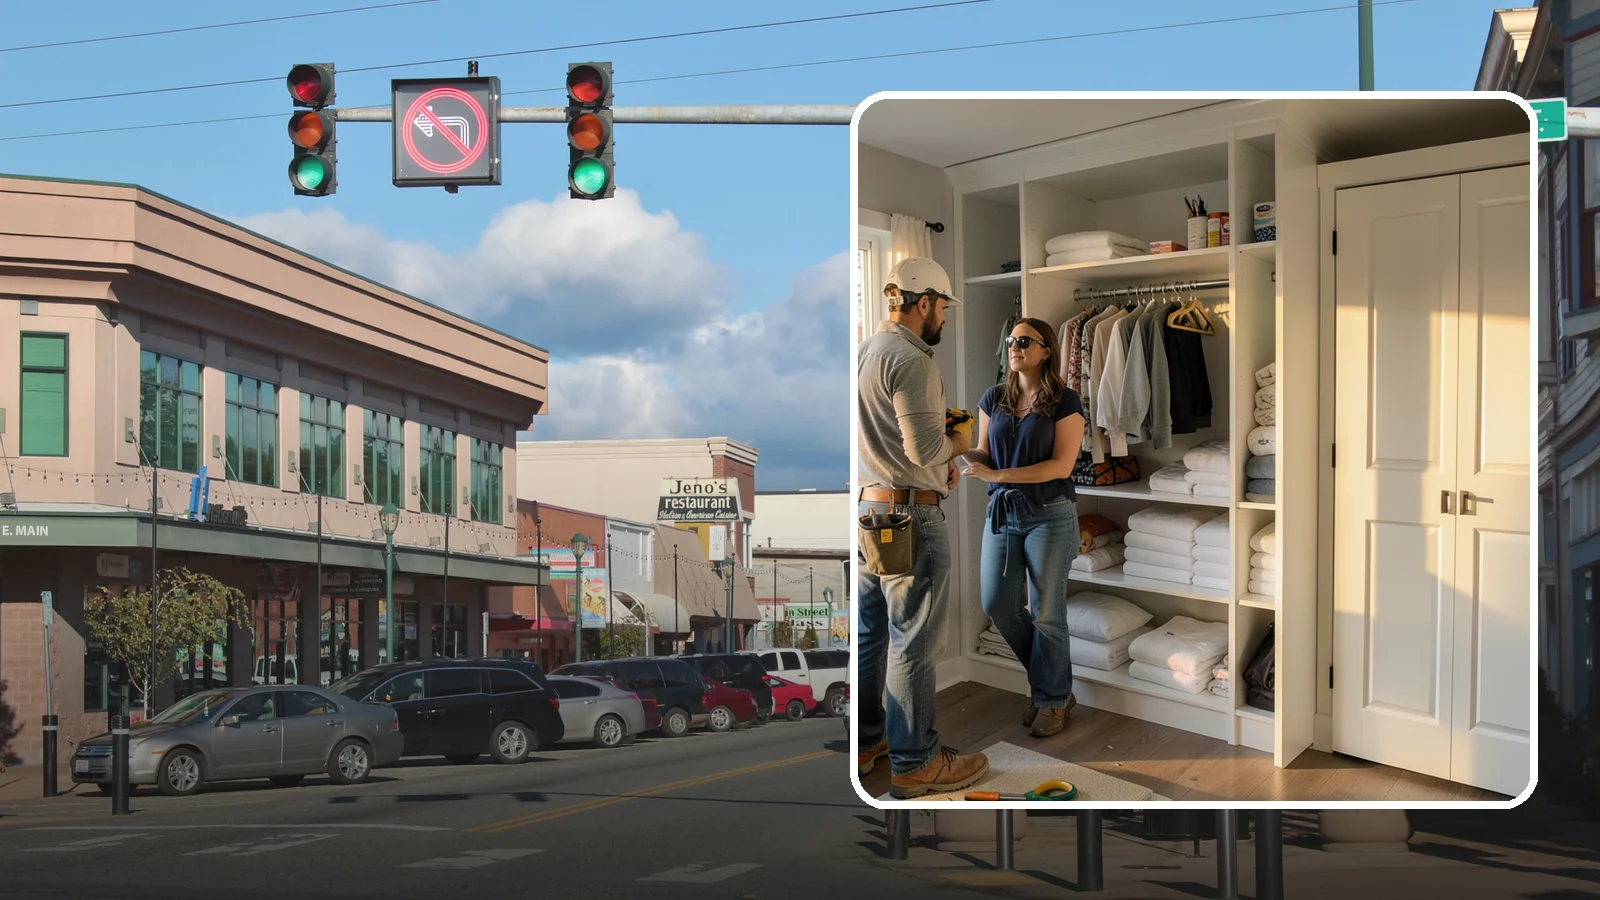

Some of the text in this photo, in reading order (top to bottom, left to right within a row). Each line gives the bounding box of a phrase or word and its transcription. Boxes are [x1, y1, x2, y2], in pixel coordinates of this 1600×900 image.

[669, 480, 728, 495] Jeno's
[665, 496, 731, 509] restaurant
[658, 510, 681, 519] Italian
[686, 510, 714, 519] American
[715, 509, 738, 519] Cuisine
[2, 525, 49, 536] E. MAIN
[797, 607, 828, 617] Street
[790, 619, 823, 627] lass
